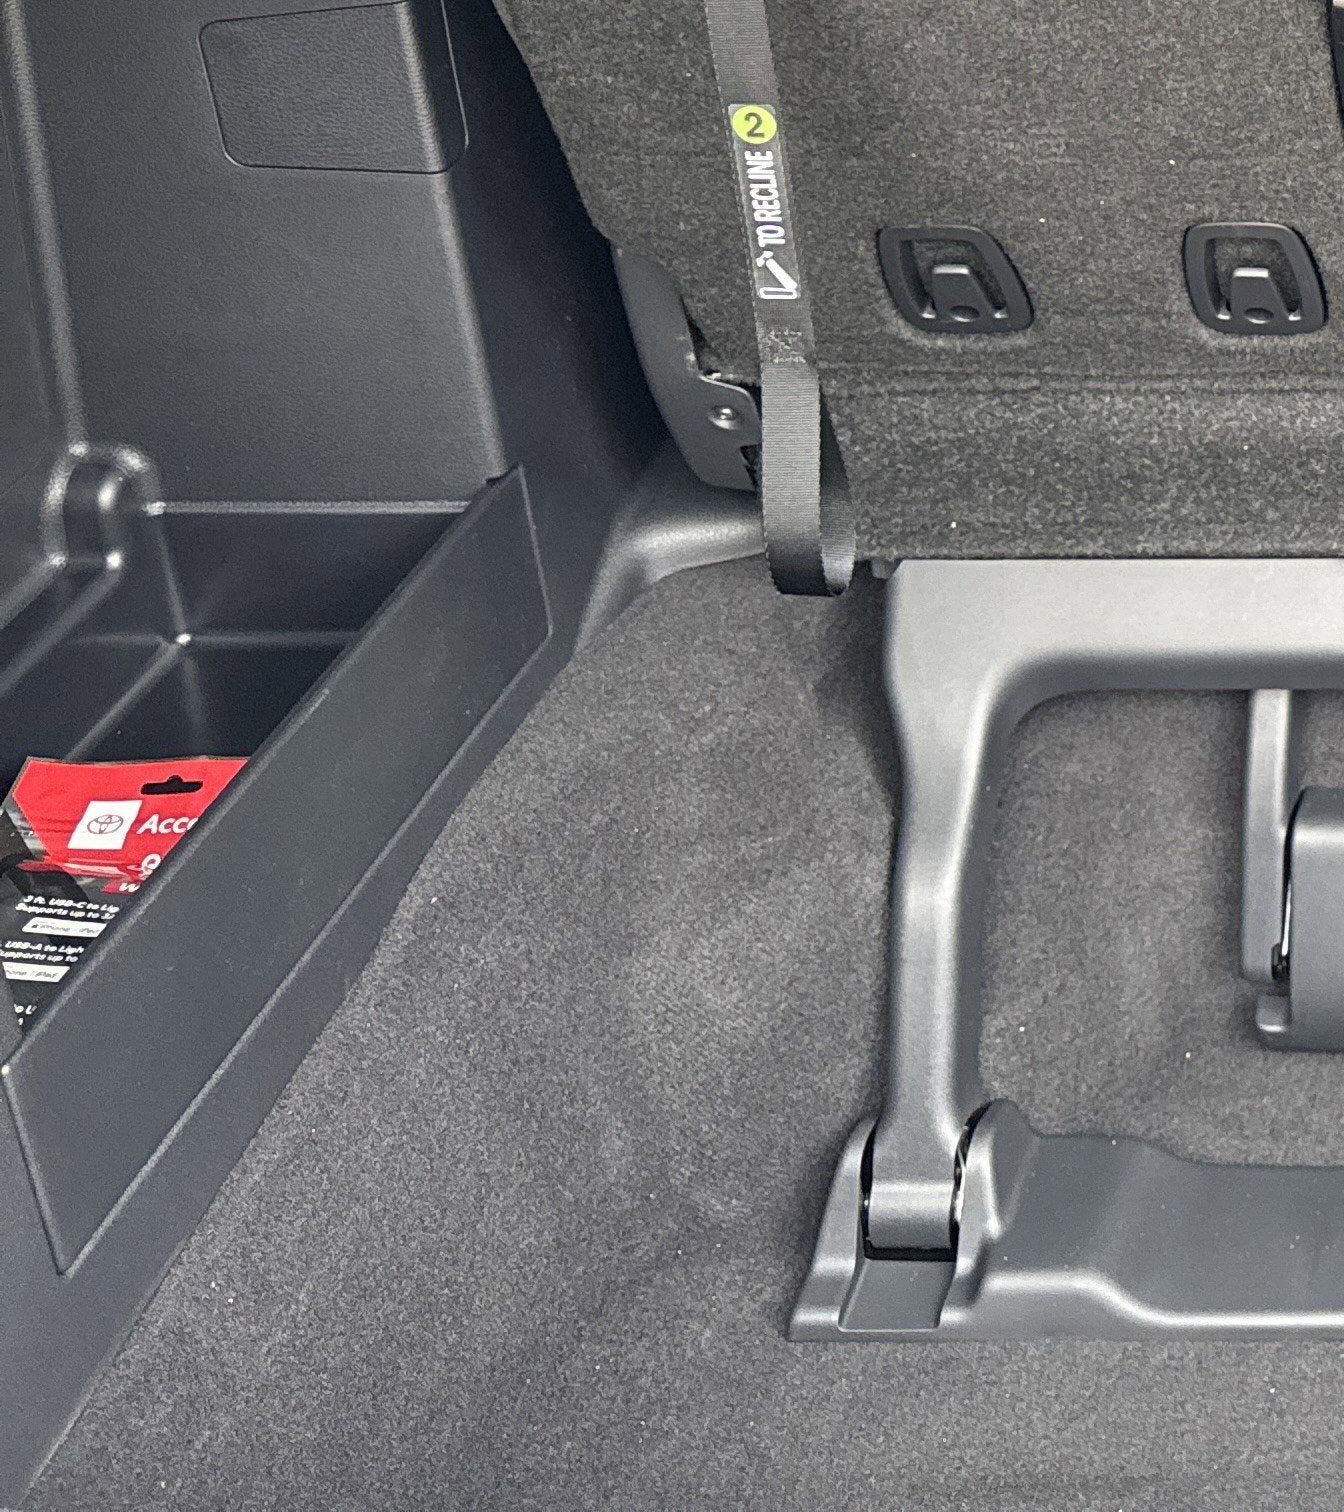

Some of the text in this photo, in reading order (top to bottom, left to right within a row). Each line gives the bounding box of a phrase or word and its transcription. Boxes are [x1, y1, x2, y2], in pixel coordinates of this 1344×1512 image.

[744, 111, 765, 138] 2
[744, 150, 786, 248] TO RECLINE
[15, 902, 69, 916] Supports
